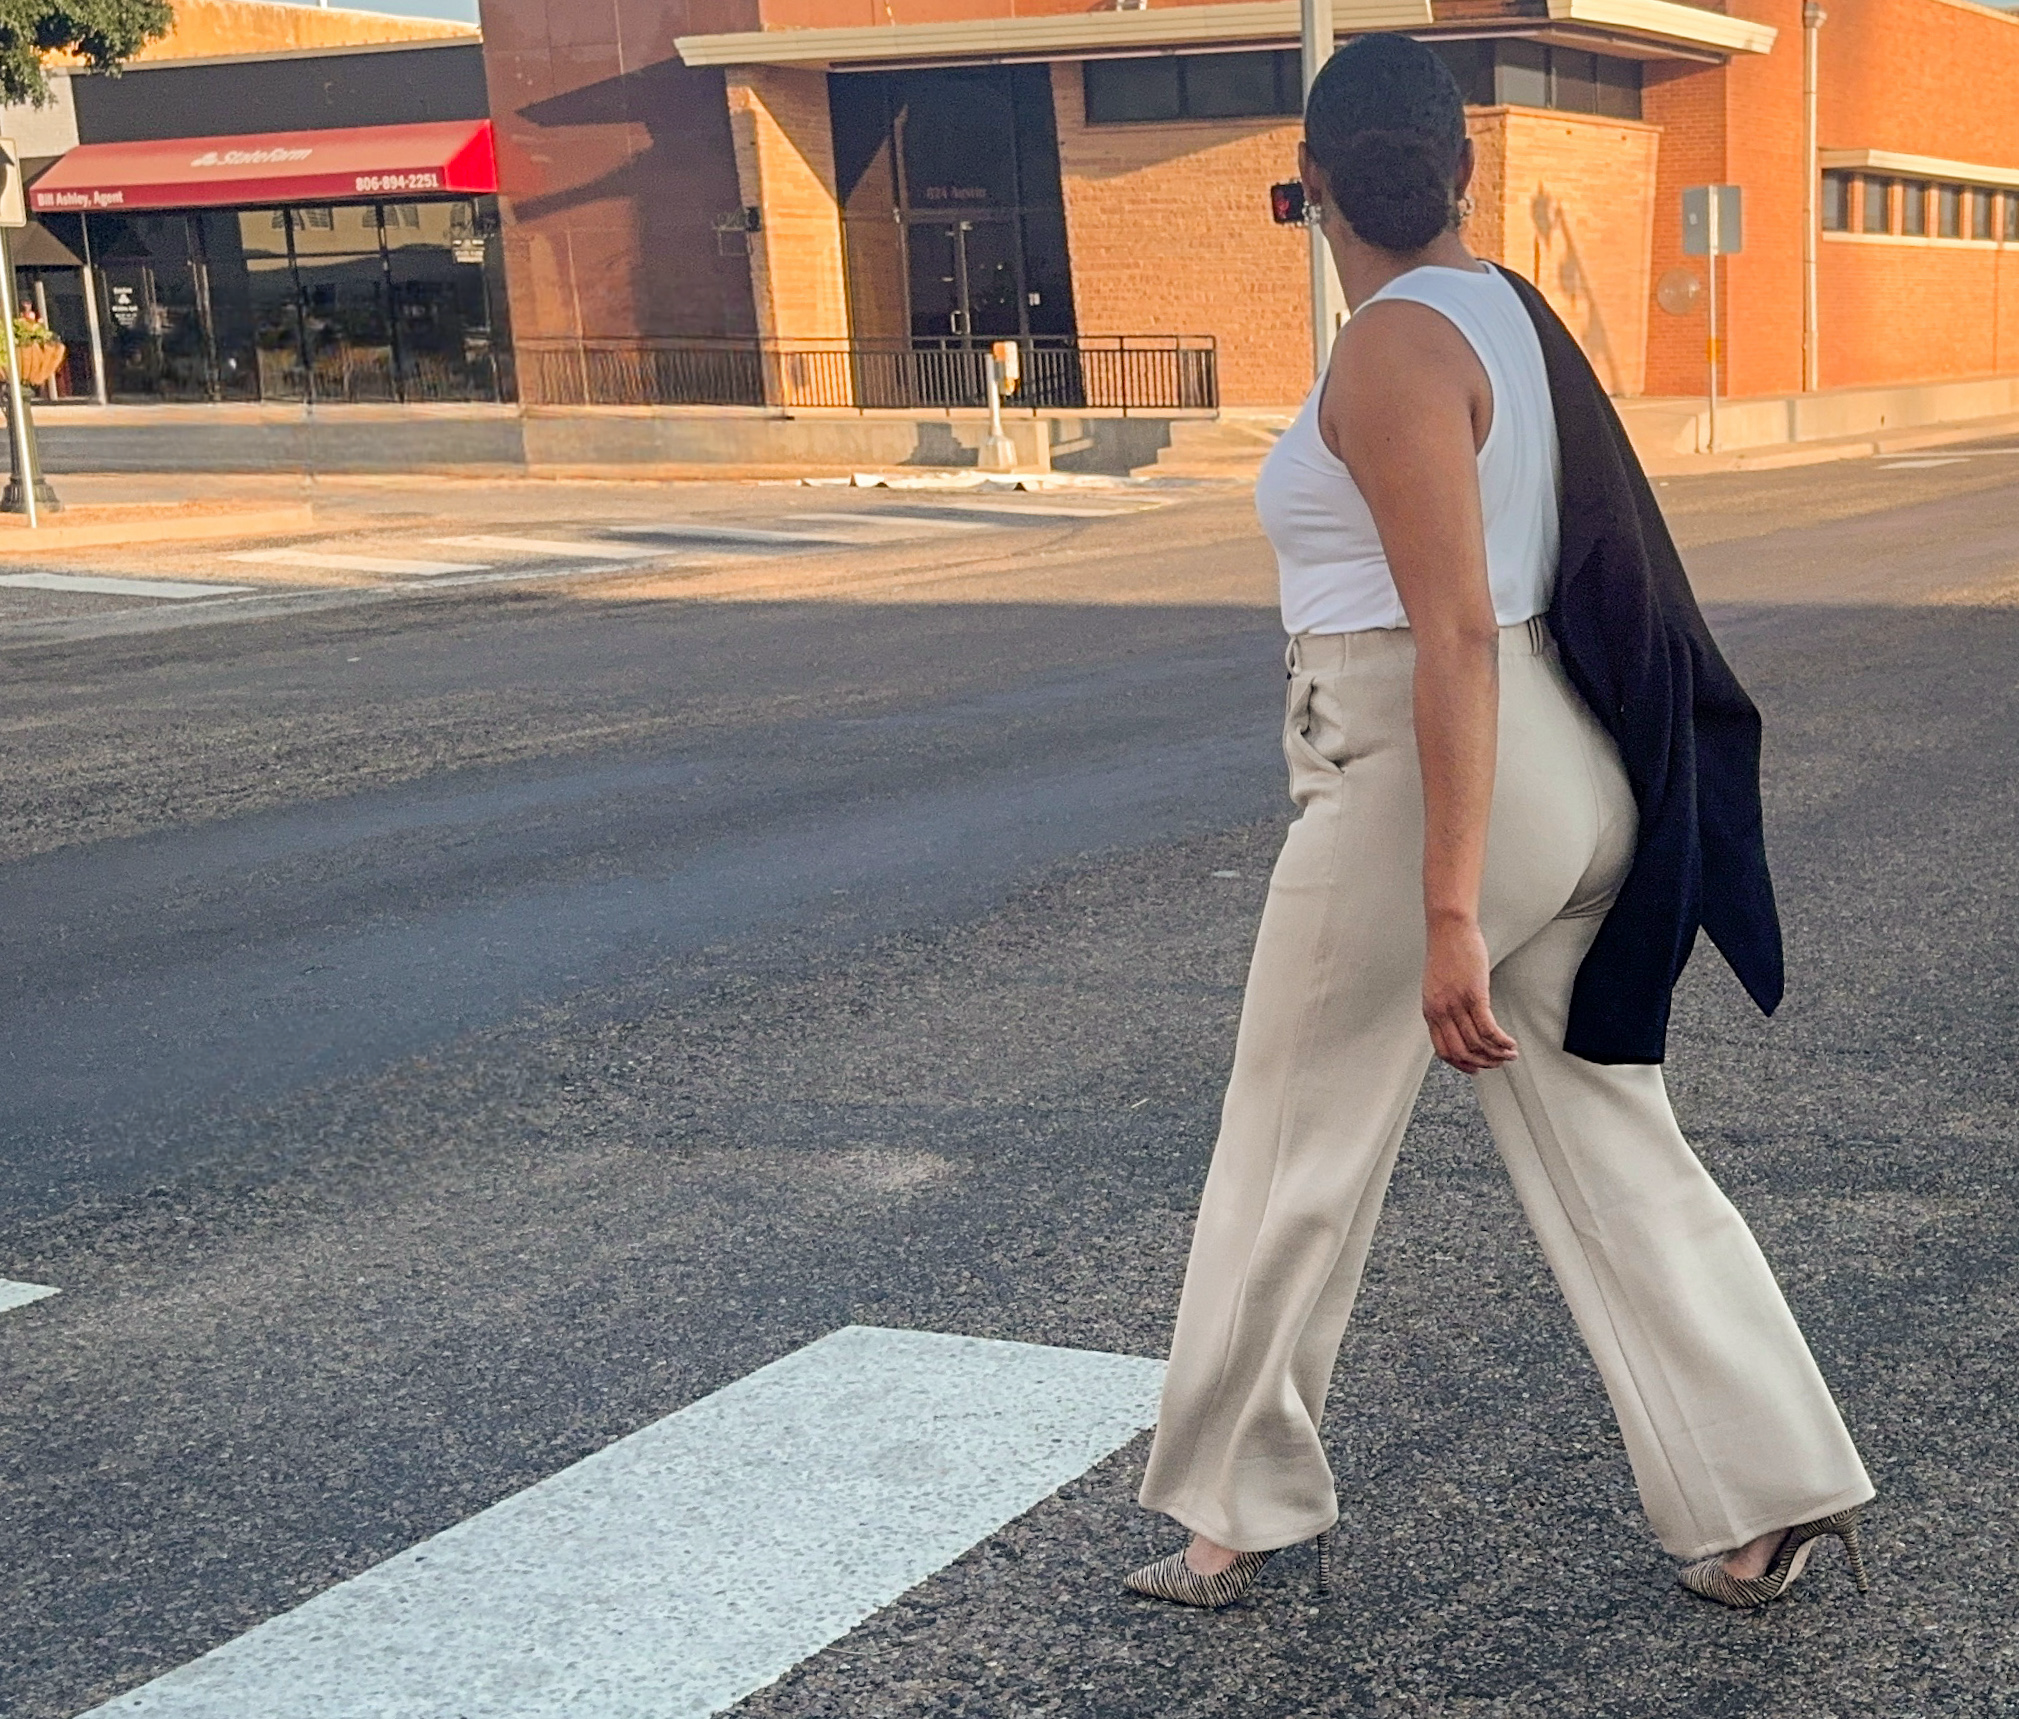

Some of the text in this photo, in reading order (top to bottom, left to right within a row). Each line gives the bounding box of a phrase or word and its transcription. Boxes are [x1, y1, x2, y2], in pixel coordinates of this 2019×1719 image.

[355, 173, 439, 192] 806-894-2251
[37, 190, 124, 208] Bill Ashley, Agent
